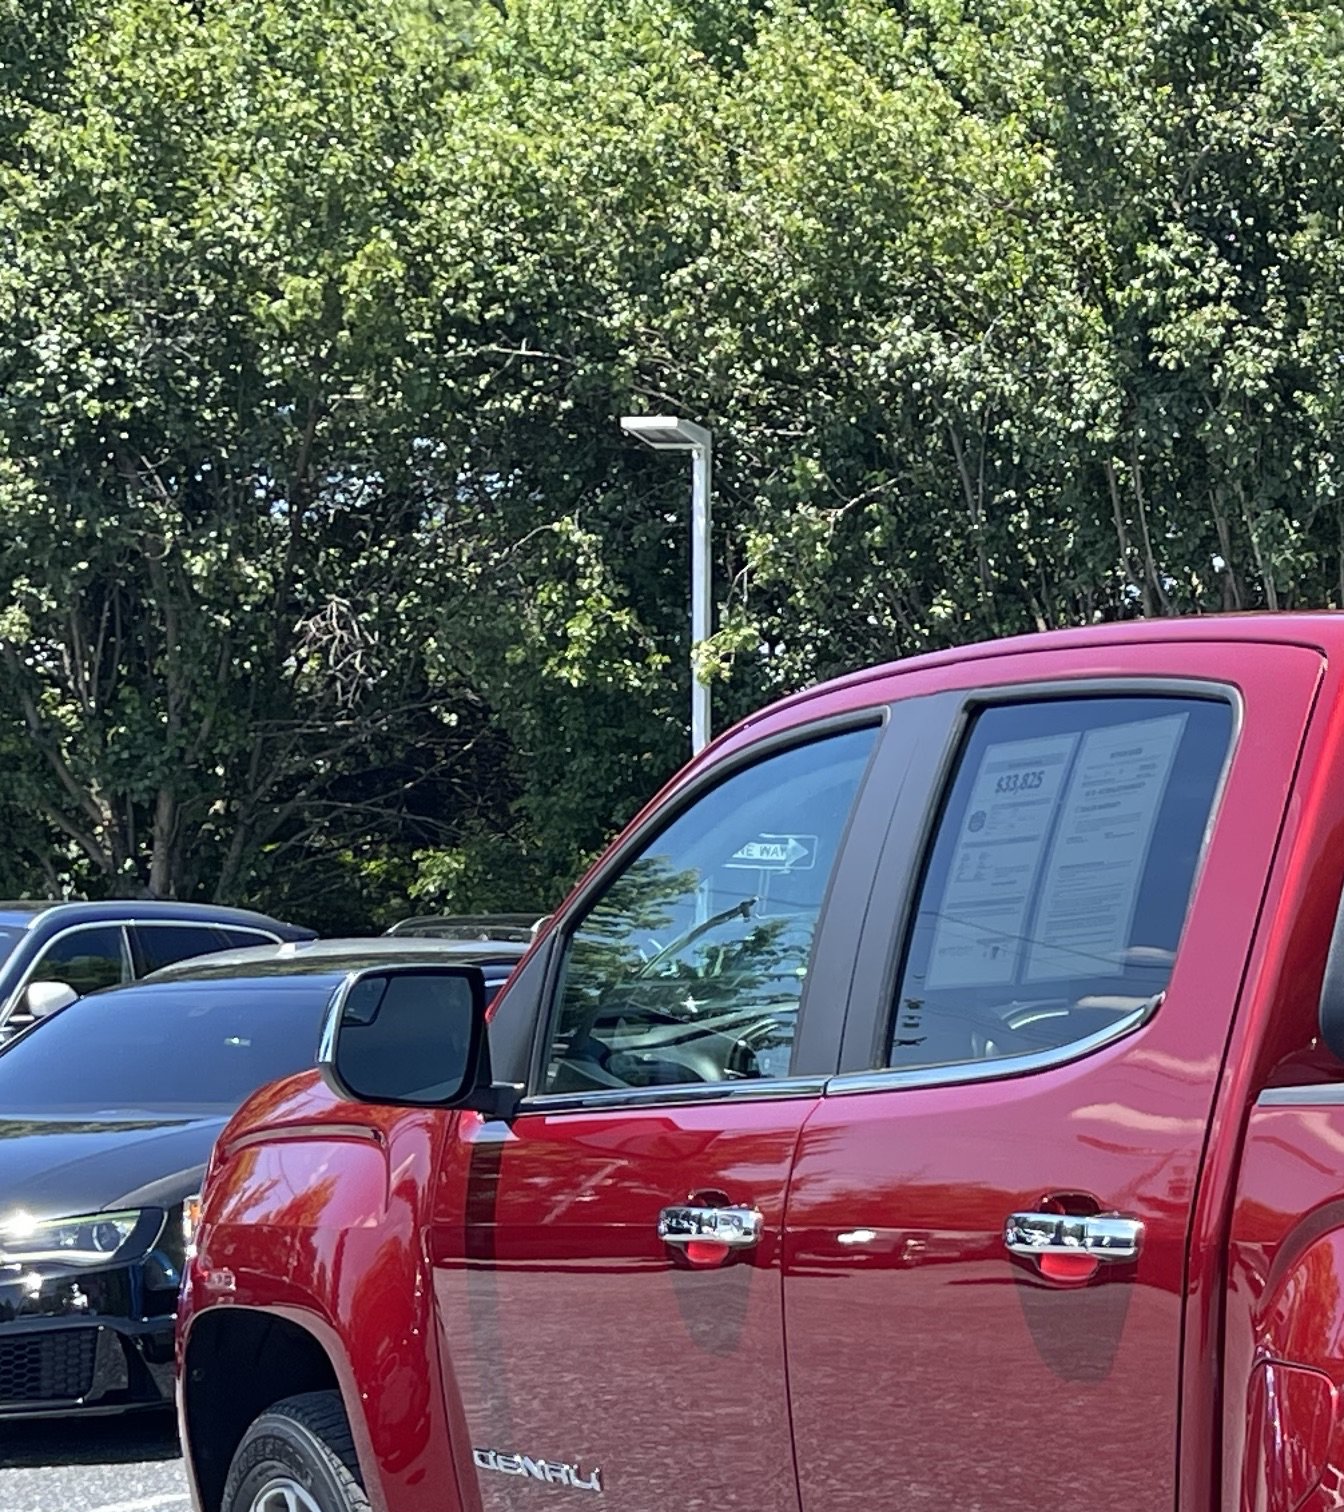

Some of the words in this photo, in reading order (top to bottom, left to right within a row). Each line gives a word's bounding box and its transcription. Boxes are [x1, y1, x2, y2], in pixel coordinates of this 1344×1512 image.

[994, 770, 1046, 795] $33,825
[759, 846, 787, 858] WAY
[471, 1448, 604, 1493] DENALI
